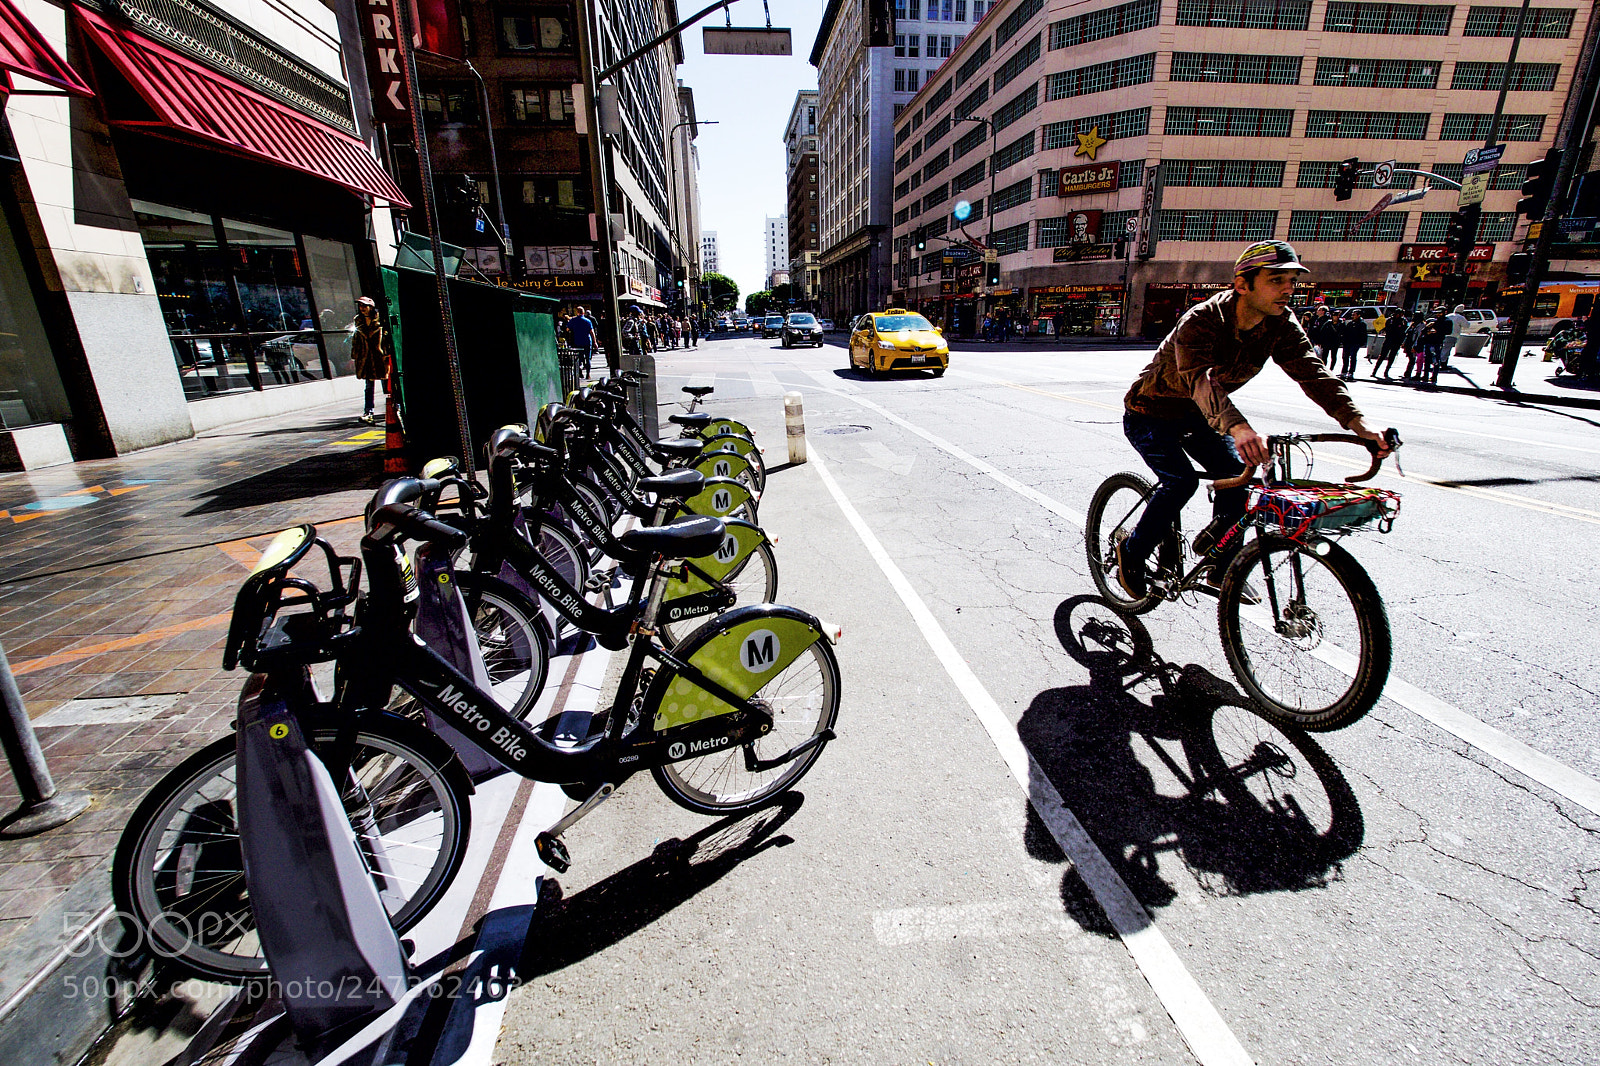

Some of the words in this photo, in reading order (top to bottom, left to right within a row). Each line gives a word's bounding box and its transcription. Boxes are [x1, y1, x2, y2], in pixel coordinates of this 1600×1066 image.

[1062, 170, 1096, 185] Carl's
[1097, 167, 1115, 181] Jr.
[1064, 180, 1111, 192] HAMBURGERS
[1140, 169, 1156, 254] PARKING
[1419, 249, 1443, 259] KFC
[1469, 248, 1489, 257] KFC
[543, 279, 553, 290] &
[555, 276, 584, 288] Loan
[1055, 285, 1071, 293] Gold
[631, 427, 646, 444] Metro
[617, 443, 635, 463] Metro
[633, 461, 646, 476] Bike
[716, 463, 728, 476] M
[603, 468, 622, 491] Metro
[620, 489, 634, 506] Bike
[715, 492, 728, 509] M
[570, 500, 593, 527] Metro
[591, 524, 608, 544] Bike
[718, 537, 735, 559] M
[529, 563, 561, 597] Metro
[560, 593, 583, 618] Bike
[683, 605, 709, 616] Metro
[747, 635, 774, 667] M
[436, 684, 491, 731] Metro
[490, 726, 527, 761] Bike
[690, 736, 729, 753] Metro
